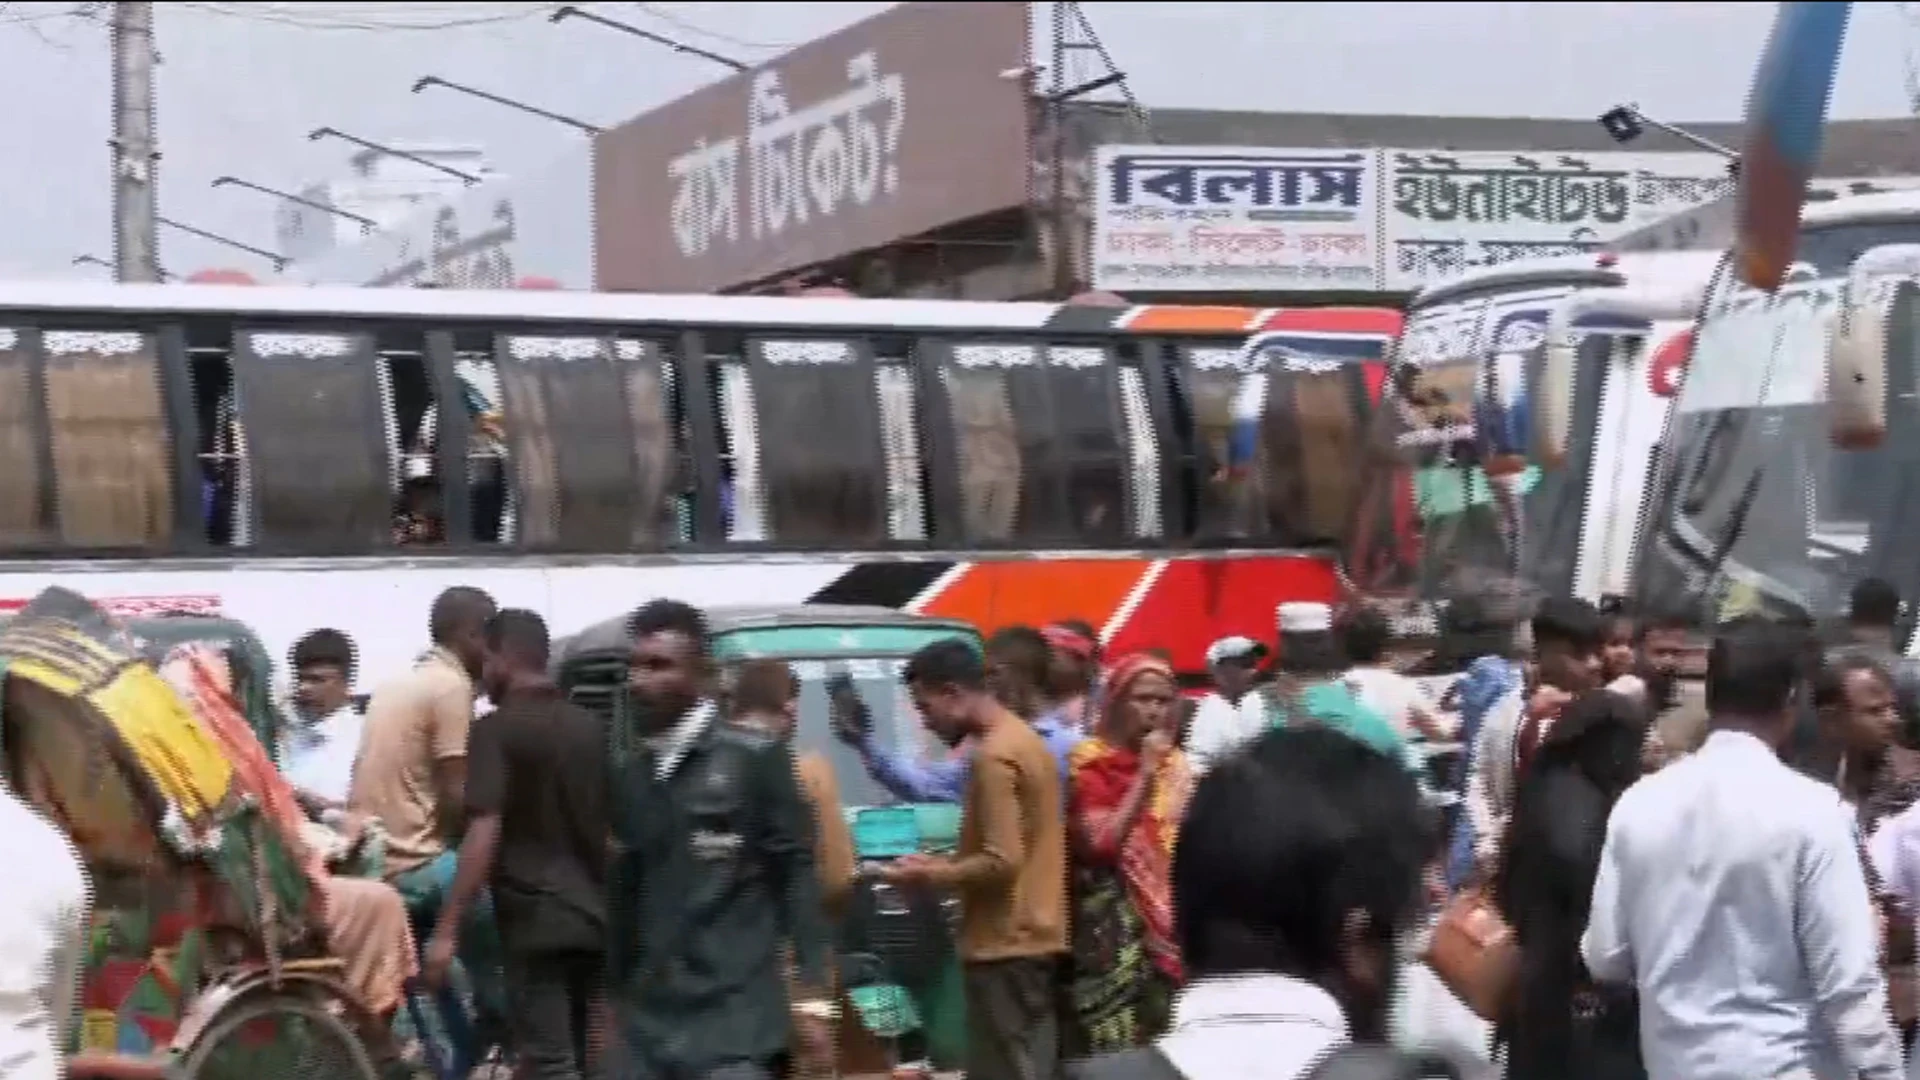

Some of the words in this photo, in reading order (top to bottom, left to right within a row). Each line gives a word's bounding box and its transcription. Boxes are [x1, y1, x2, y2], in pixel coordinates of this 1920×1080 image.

[667, 136, 740, 256] বাস
[1107, 153, 1366, 206] বিলাস
[1394, 151, 1629, 224] ইউনাইটেড
